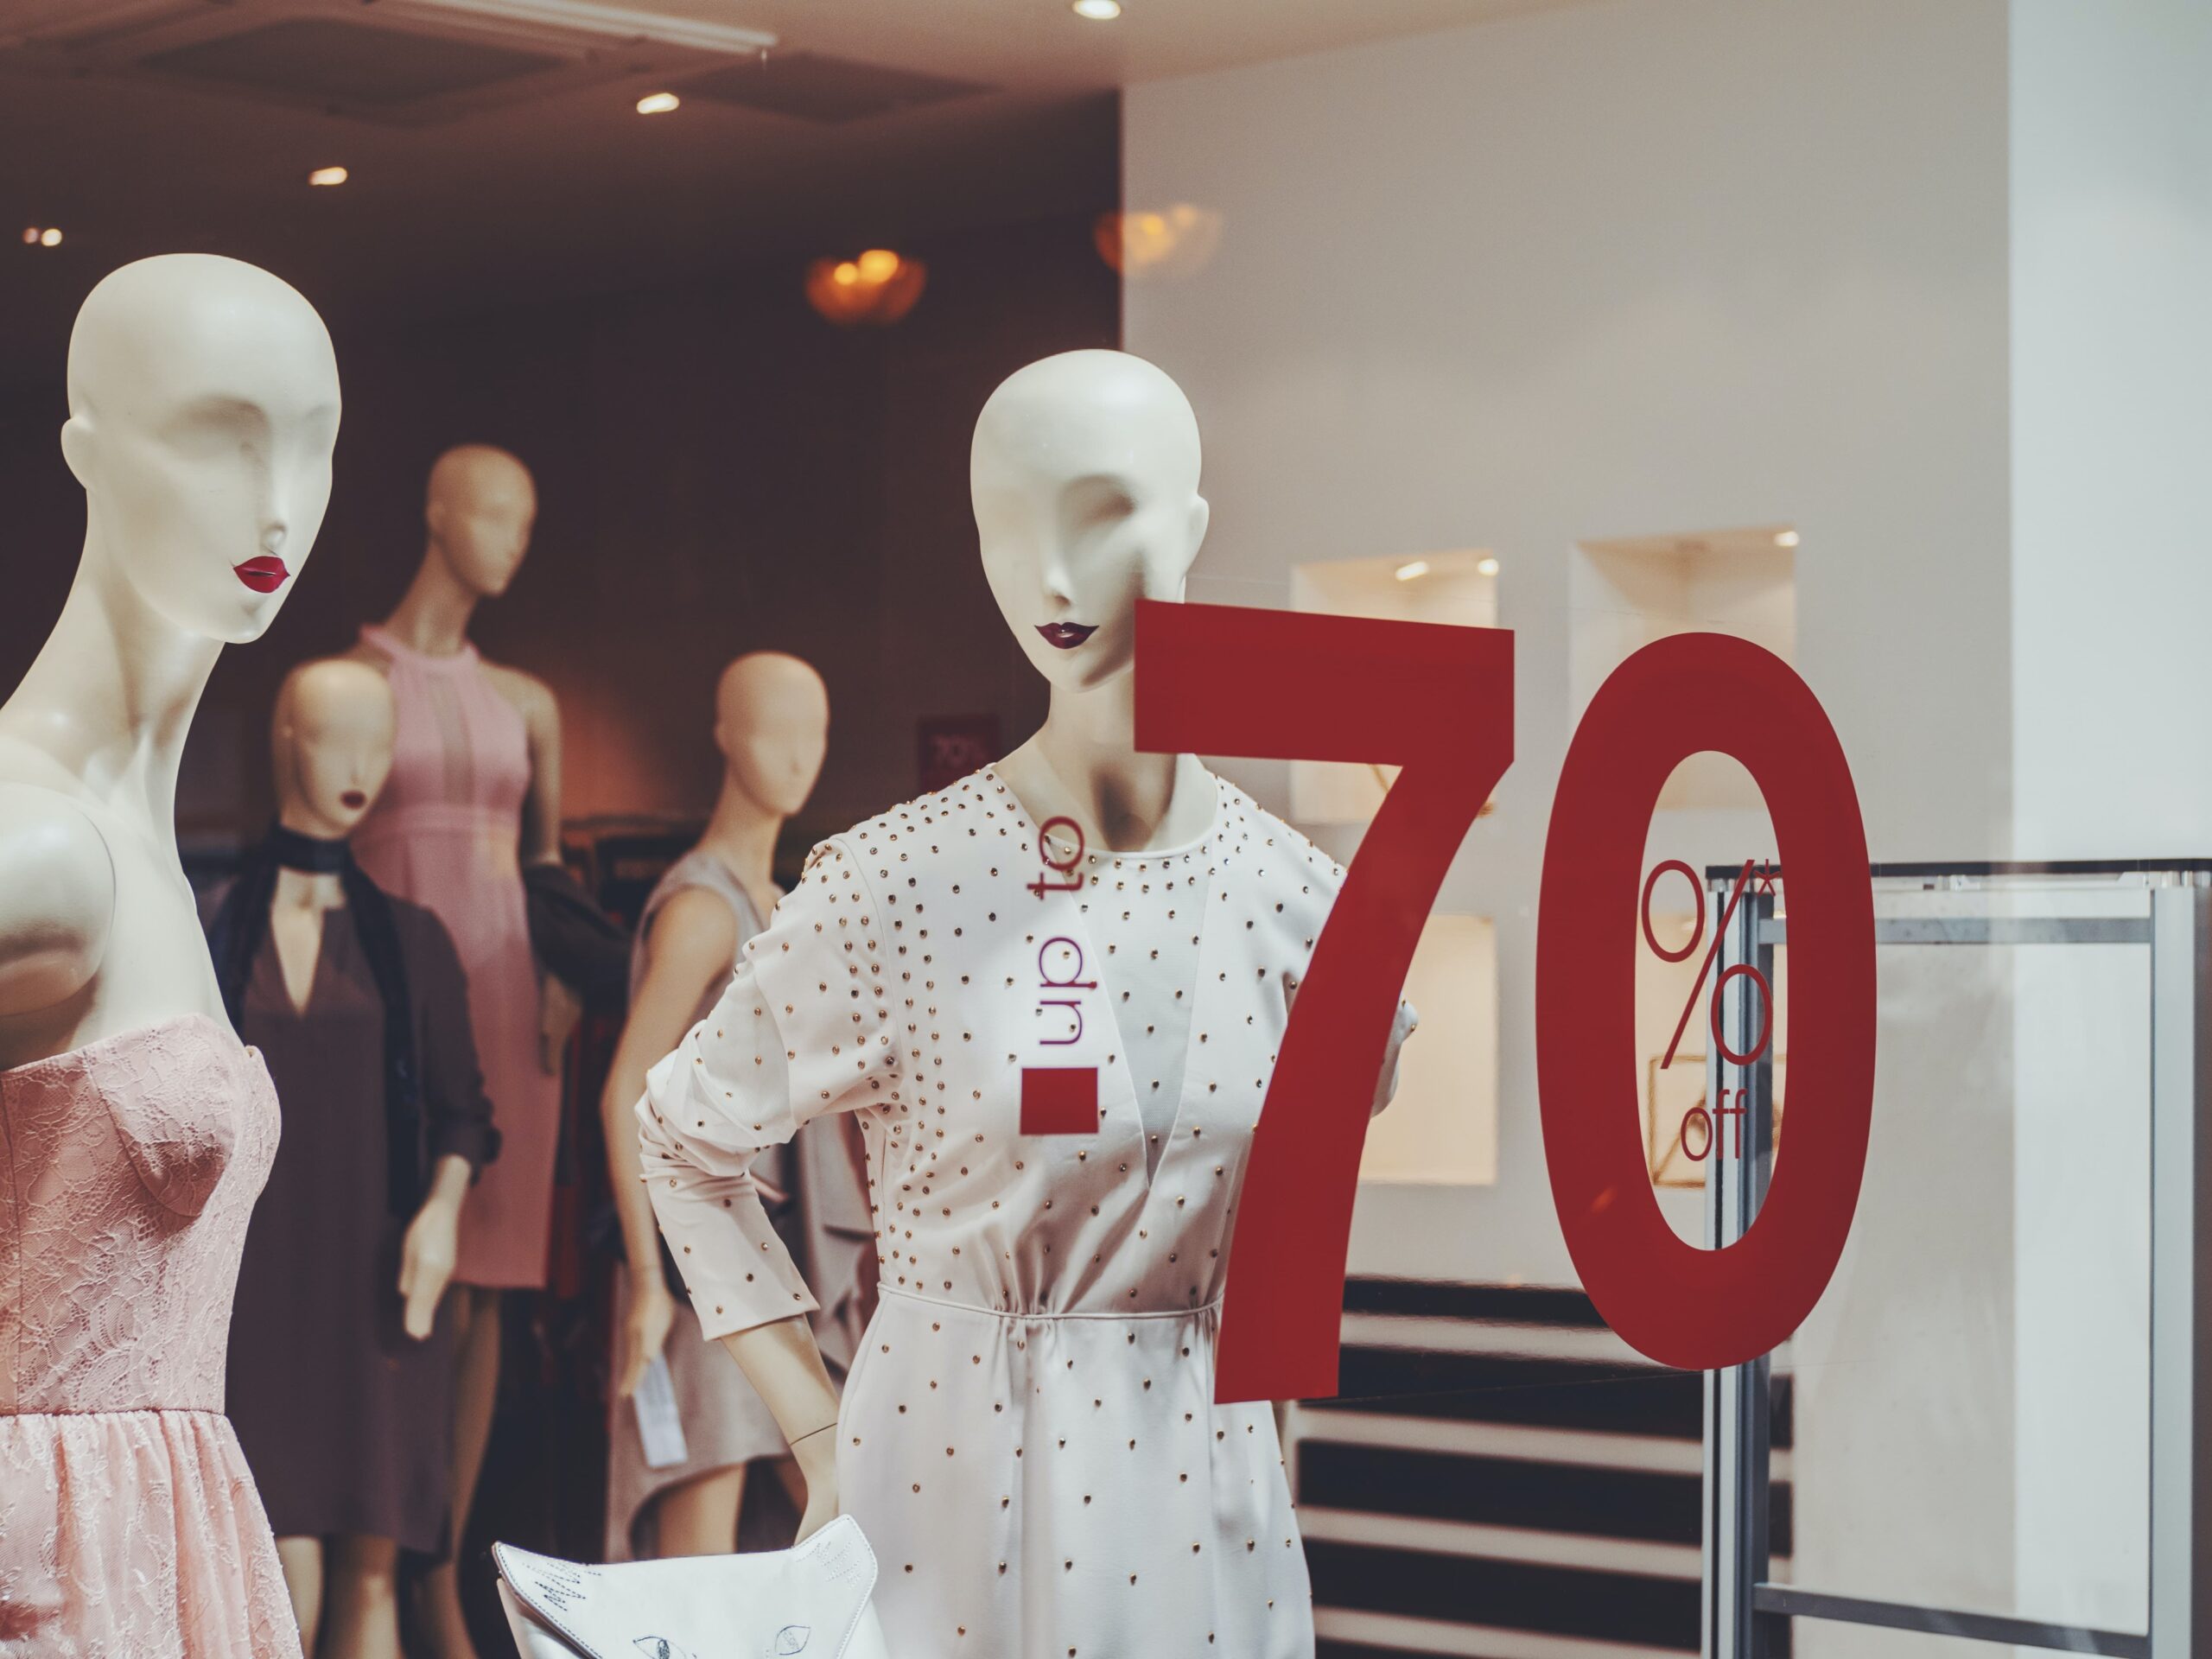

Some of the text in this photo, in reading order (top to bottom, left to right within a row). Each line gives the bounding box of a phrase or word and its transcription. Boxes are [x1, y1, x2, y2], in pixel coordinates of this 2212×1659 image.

[1026, 816, 1098, 1046] up to
[1681, 1089, 1748, 1161] off
